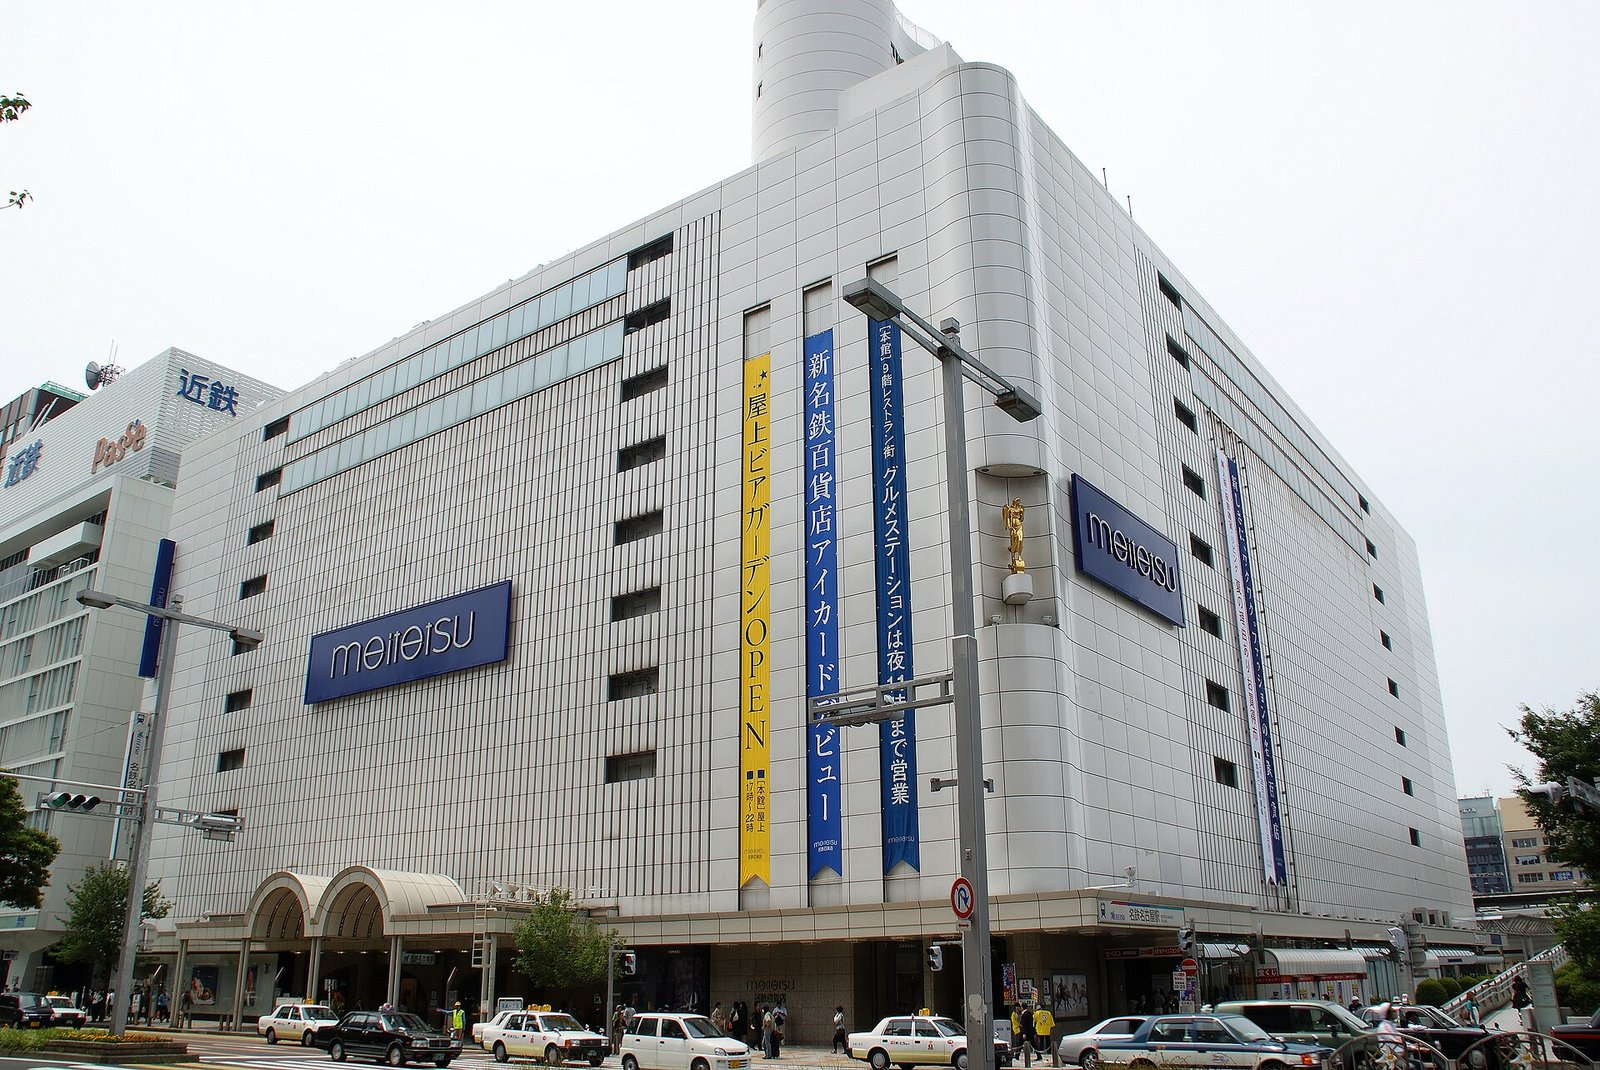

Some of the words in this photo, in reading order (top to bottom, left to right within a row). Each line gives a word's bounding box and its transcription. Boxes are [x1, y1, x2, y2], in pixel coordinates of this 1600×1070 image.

[177, 368, 239, 416] 近鉄
[4, 438, 43, 489] 近鉄
[1088, 511, 1177, 593] meitetsu
[330, 611, 476, 679] meitetsu
[882, 465, 909, 805] グルメステーションは夜11まで営業
